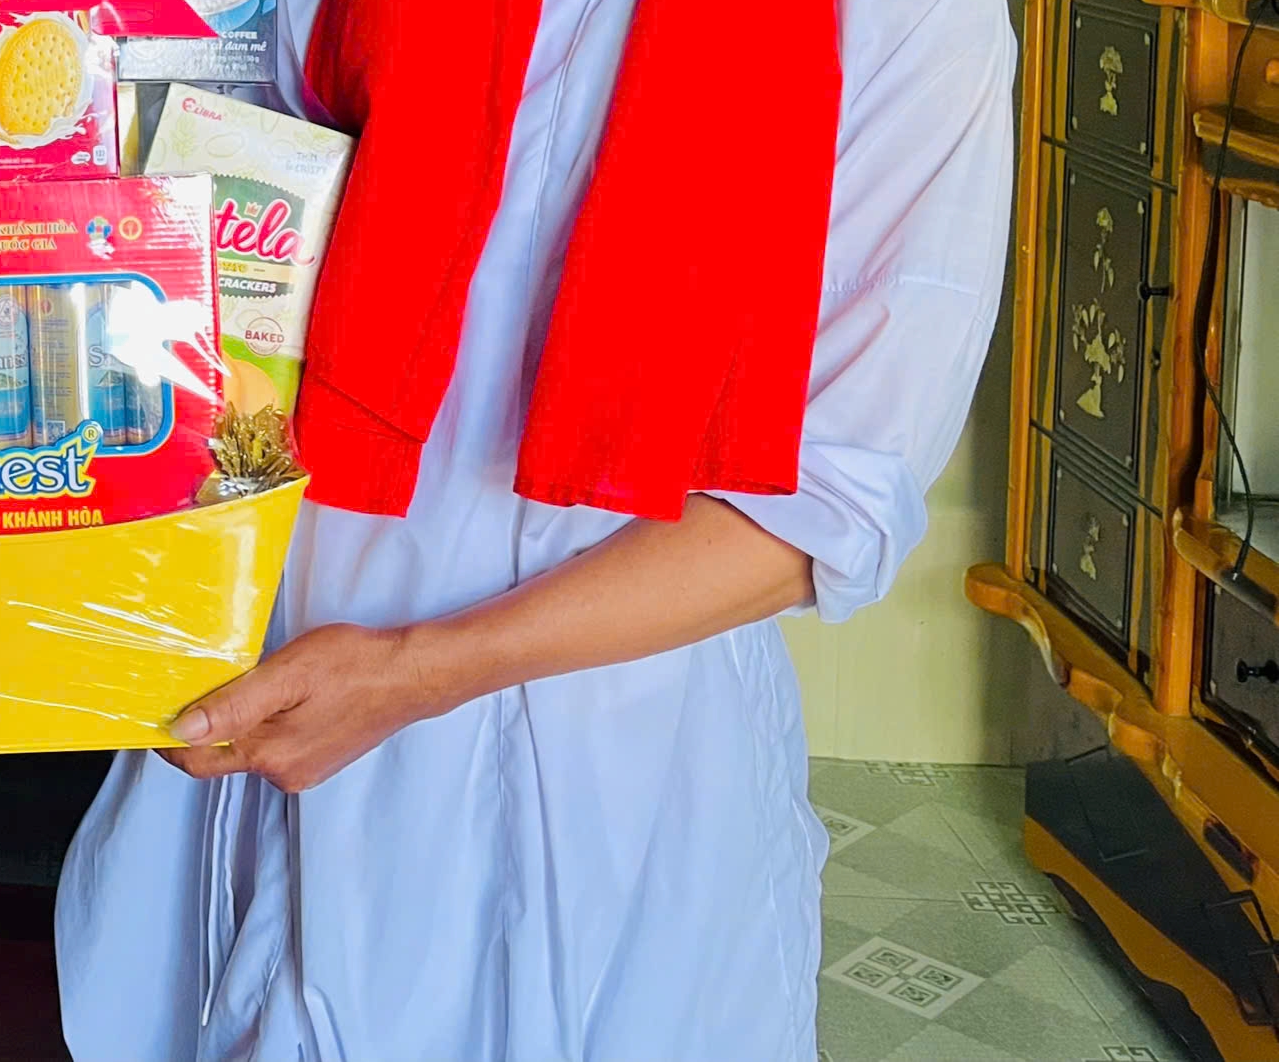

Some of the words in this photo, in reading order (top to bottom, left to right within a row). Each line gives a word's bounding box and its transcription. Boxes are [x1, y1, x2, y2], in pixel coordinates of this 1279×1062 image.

[47, 219, 78, 234] HÒA
[31, 237, 57, 250] GIA
[218, 277, 277, 294] CRACKERS
[245, 329, 285, 344] BAKED
[2, 508, 62, 529] KHÁNH
[68, 506, 104, 526] HÒA
